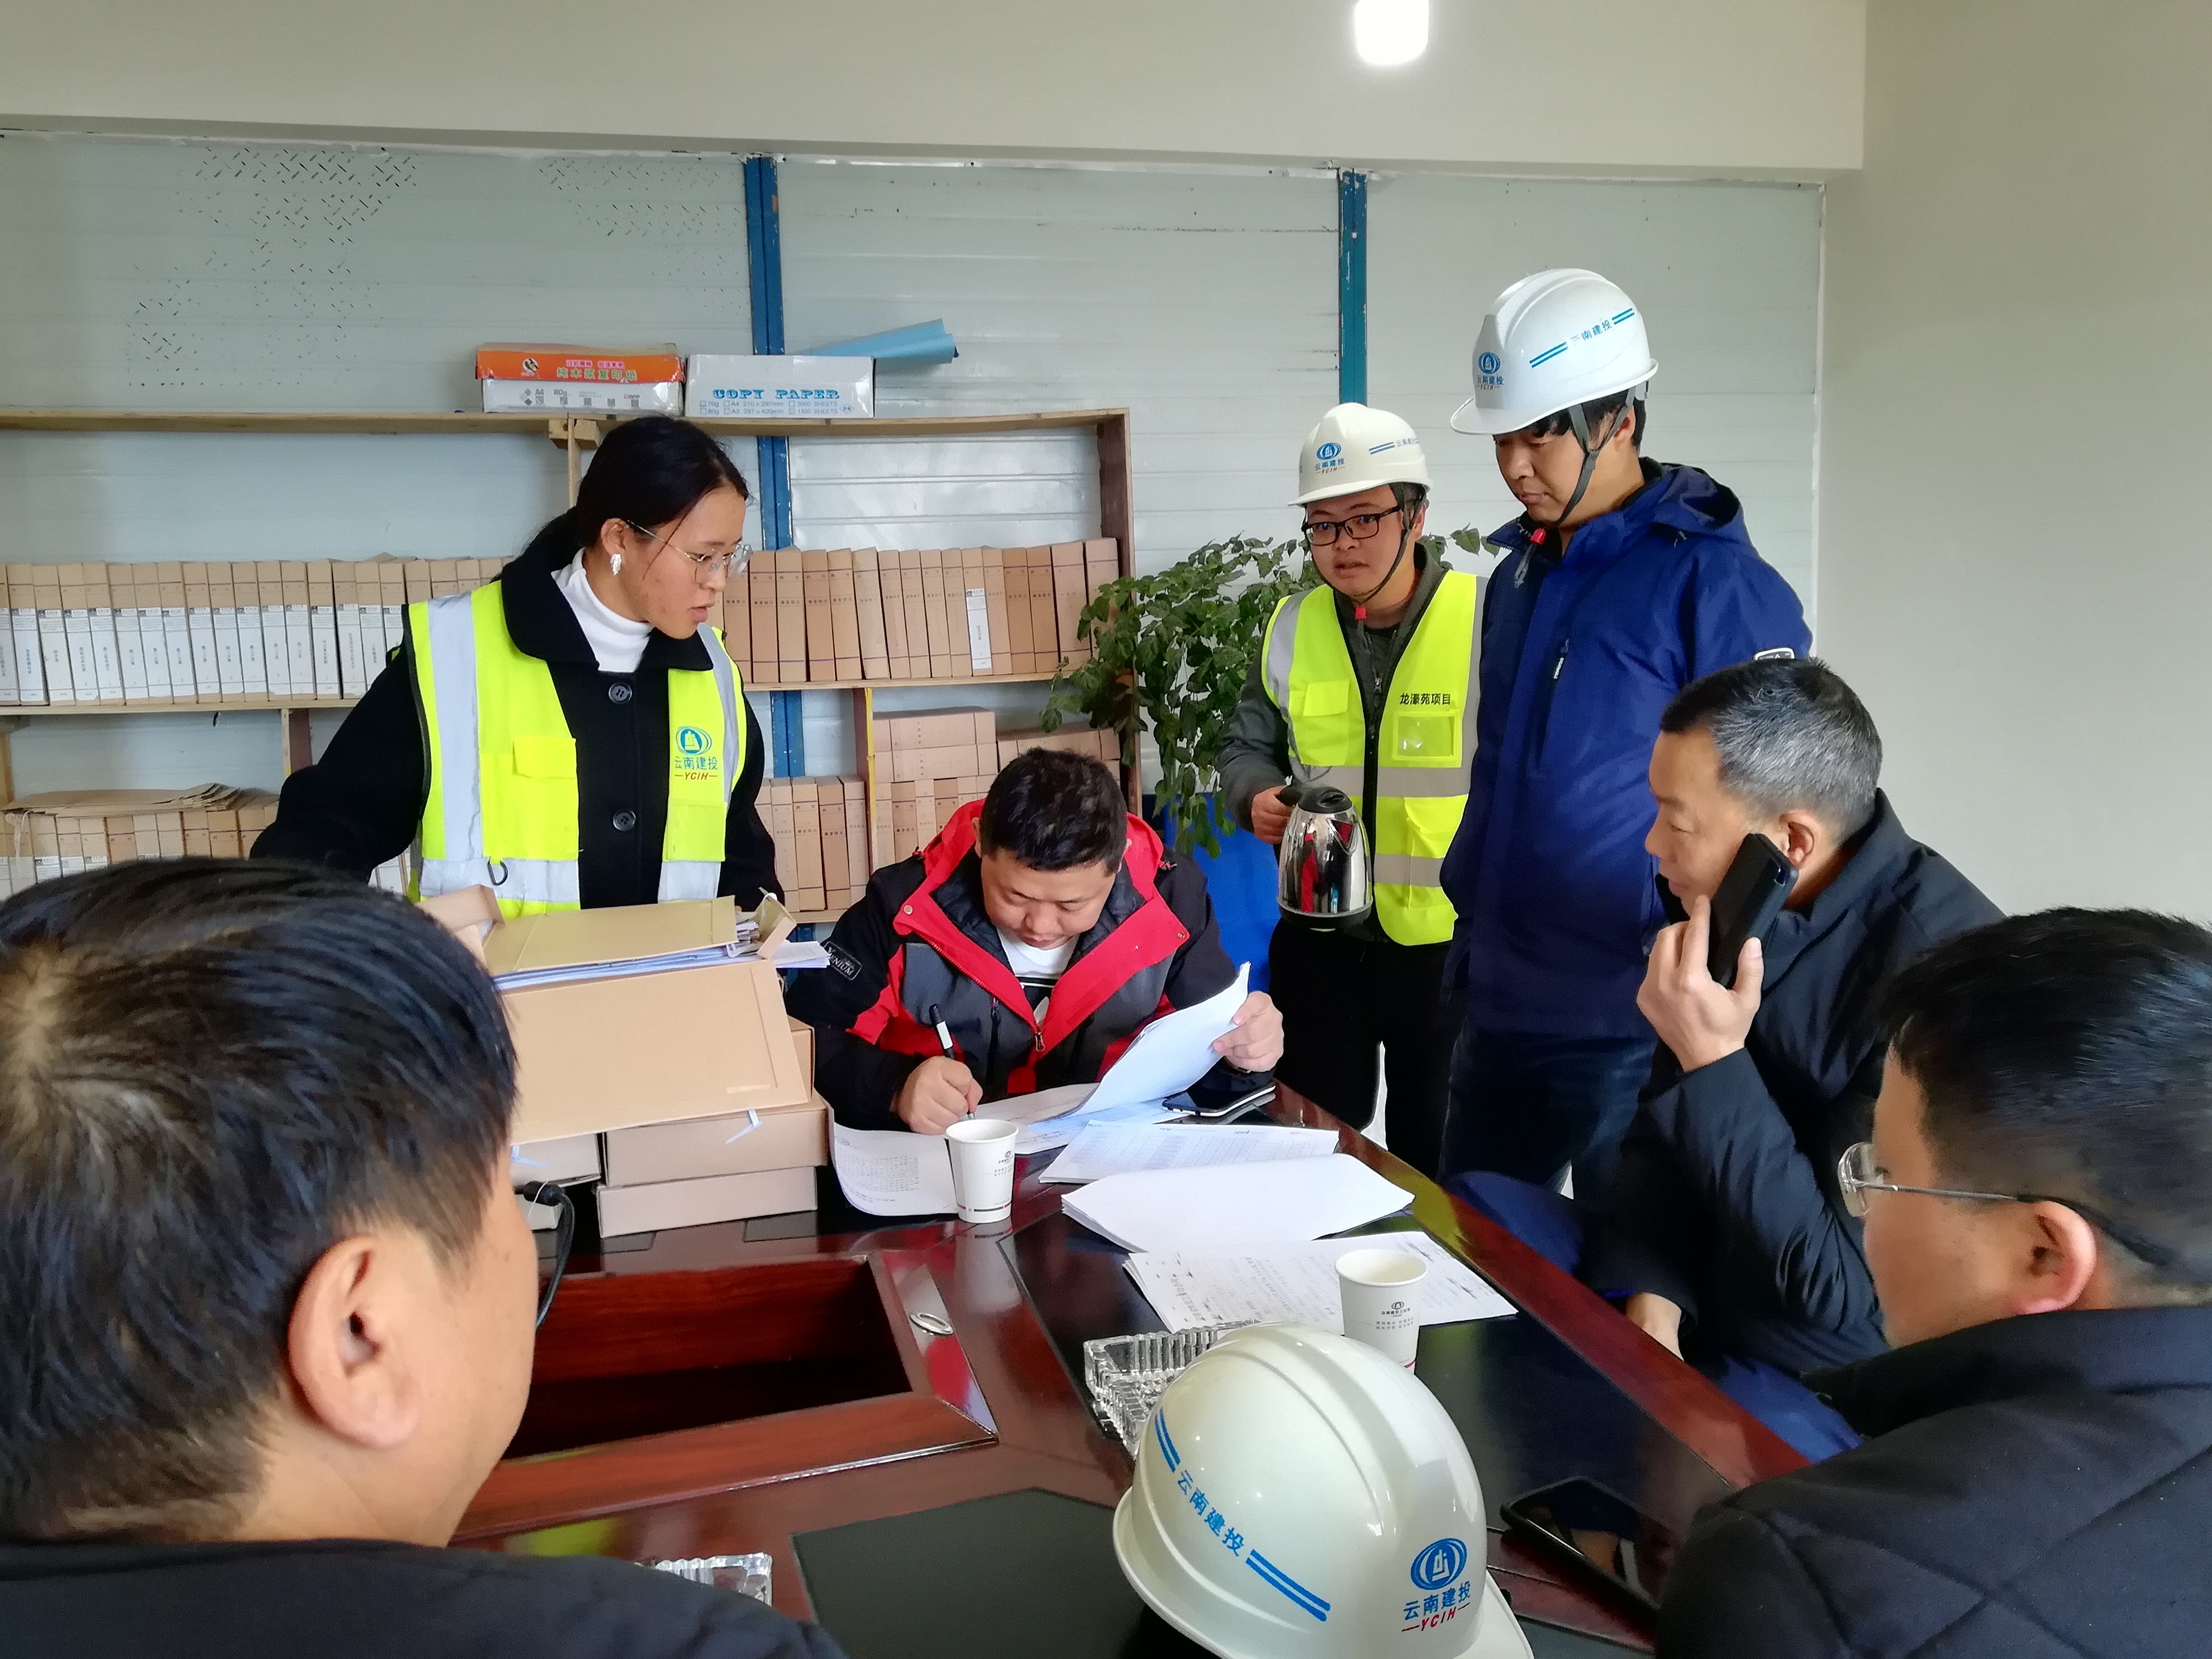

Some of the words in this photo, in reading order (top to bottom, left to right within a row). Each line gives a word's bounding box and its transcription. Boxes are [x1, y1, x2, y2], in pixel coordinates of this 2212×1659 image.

[712, 389, 764, 399] COPY
[775, 389, 840, 399] PAPER
[1314, 458, 1345, 470] 云南建投
[1400, 692, 1451, 705] 龙濠苑项目
[675, 756, 718, 770] 云南建投
[1177, 1469, 1244, 1557] 云南建投
[1403, 1580, 1471, 1621] 云南建投
[1421, 1606, 1457, 1631] YCIH
